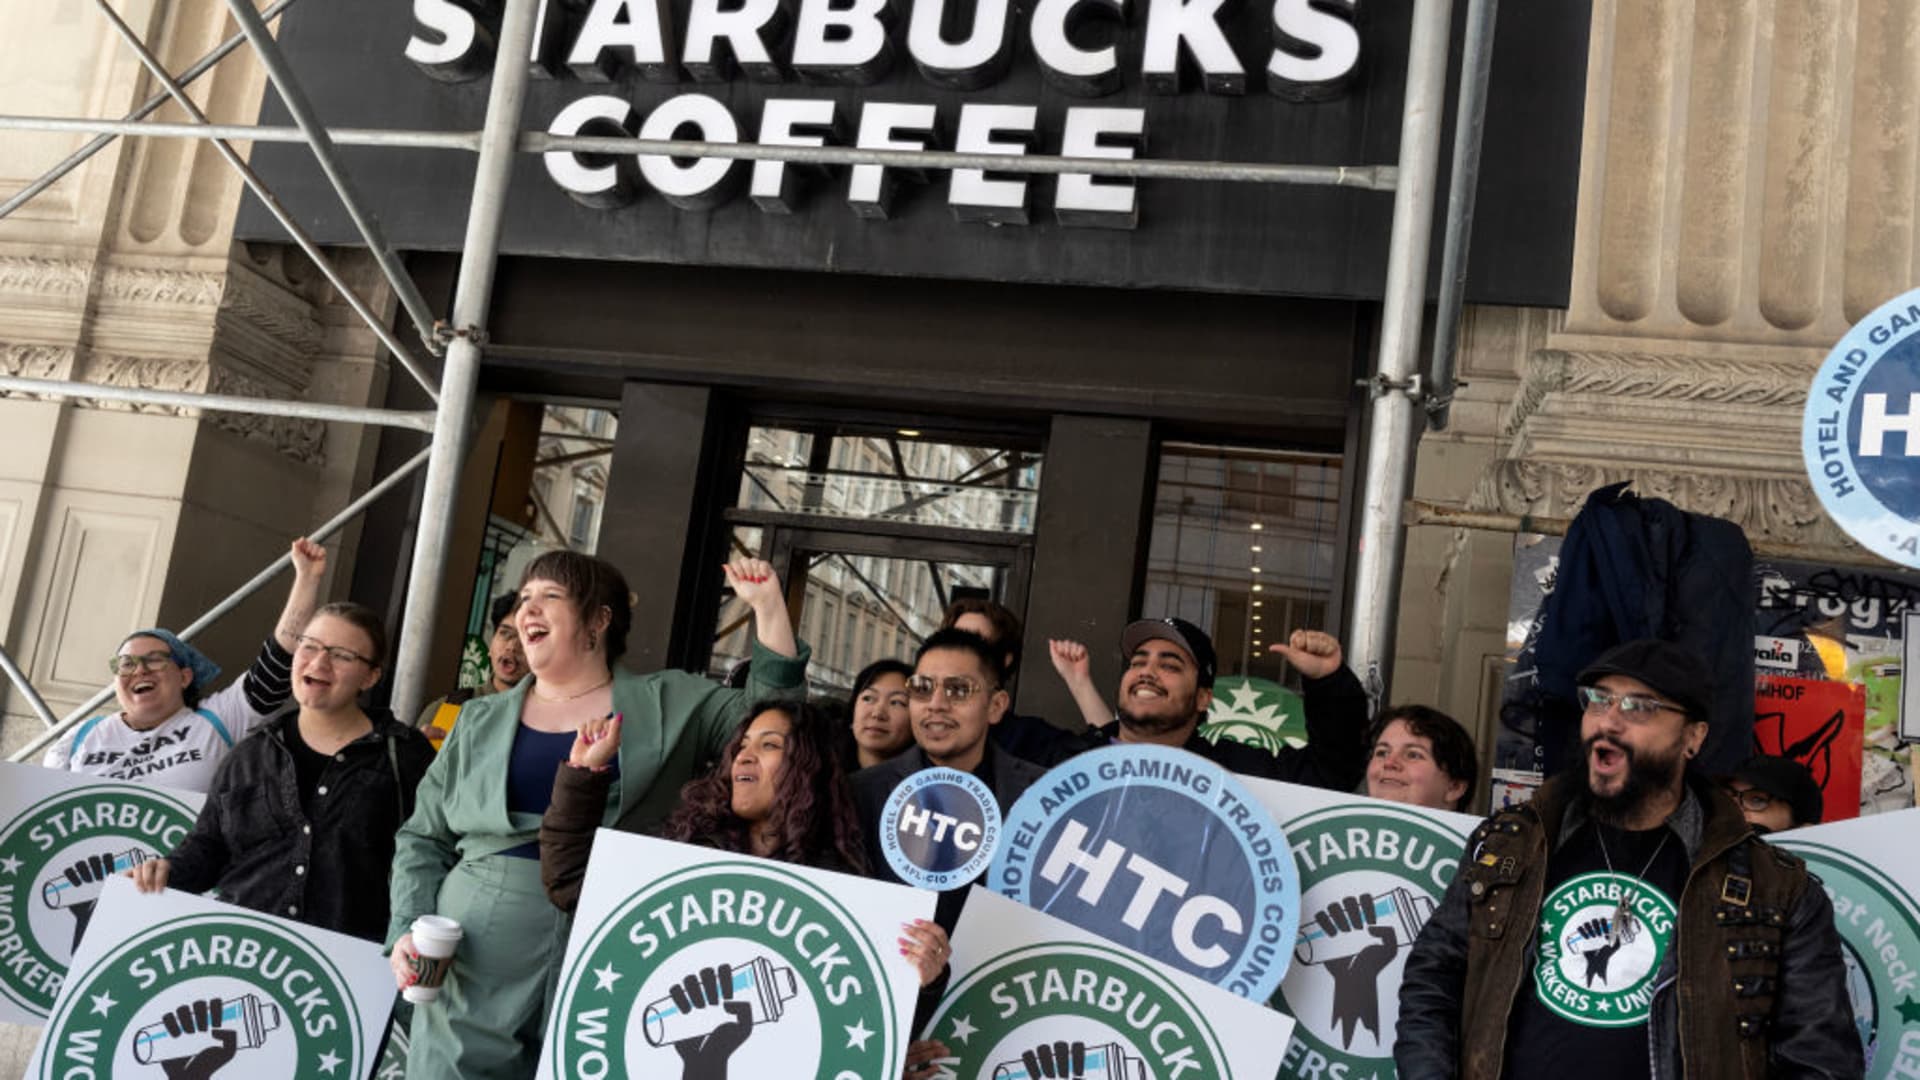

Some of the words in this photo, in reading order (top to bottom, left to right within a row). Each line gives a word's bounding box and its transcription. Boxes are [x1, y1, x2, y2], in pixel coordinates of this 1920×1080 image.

[404, 0, 1360, 83] SARBUCKS
[543, 93, 1146, 214] COFFEE
[1826, 348, 1867, 404] AND
[1818, 410, 1855, 498] HOTEL
[131, 725, 191, 756] GAY
[916, 772, 963, 785] GAMING
[967, 781, 995, 822] TRADES
[29, 803, 189, 851] STARBUC
[886, 810, 897, 850] HOTEL
[900, 804, 981, 851] HTC
[962, 826, 996, 875] COUNCIL
[1039, 771, 1091, 816] AND
[1098, 758, 1212, 794] GAMING
[1217, 789, 1283, 894] TRADES
[1040, 818, 1243, 968] HTC
[629, 888, 863, 1006] STARBUCKS
[1823, 885, 1867, 926] at
[1864, 917, 1918, 993] Neck
[129, 935, 338, 1039] STARBUCKS
[1615, 973, 1659, 1013] UNI
[575, 1008, 610, 1080] WO
[989, 968, 1202, 1080] STARBUCK
